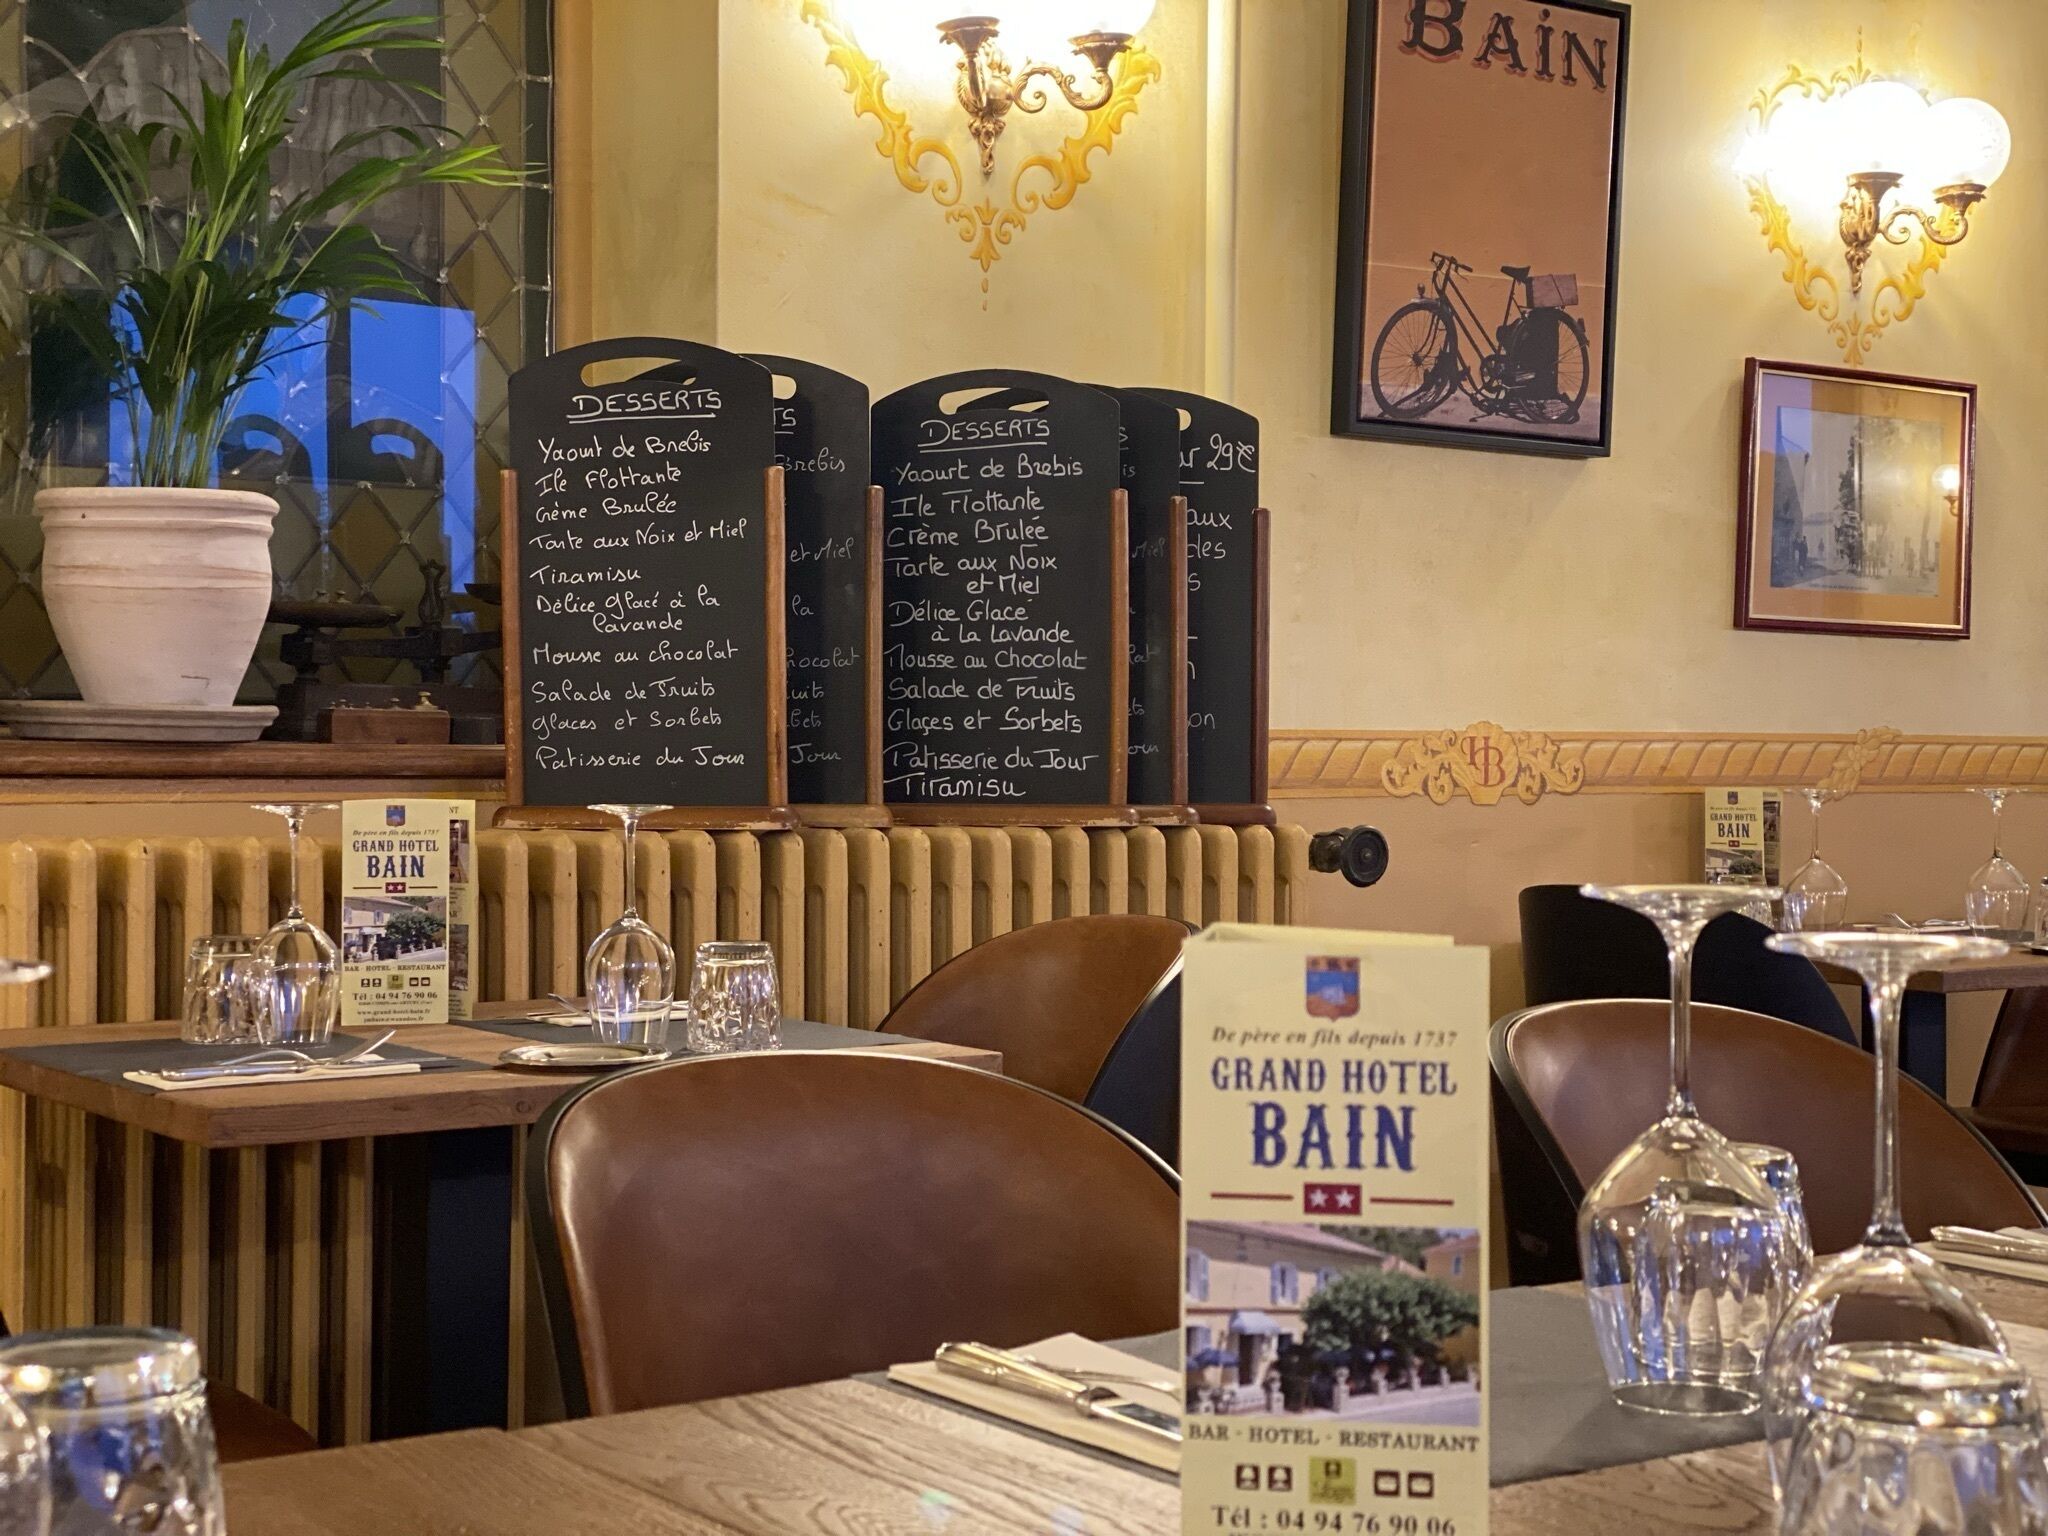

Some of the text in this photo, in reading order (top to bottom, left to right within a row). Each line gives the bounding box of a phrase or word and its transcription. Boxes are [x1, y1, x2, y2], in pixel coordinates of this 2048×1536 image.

[566, 388, 722, 418] DESSERTS
[918, 418, 1050, 448] DESSERTS
[612, 441, 635, 458] de
[585, 461, 682, 490] Flottante
[895, 453, 1083, 485] Yaourt de Brebis
[891, 486, 1045, 517] Ile Flottante
[593, 534, 629, 548] aux
[635, 522, 675, 545] Noix
[684, 520, 702, 542] et
[709, 518, 747, 540] Miel
[887, 516, 1049, 547] Crème Brulée
[884, 544, 1058, 577] Tarte aux Noix
[529, 565, 641, 585] Tiramisu
[967, 572, 1040, 595] et Miel
[670, 592, 686, 608] à
[697, 584, 720, 607] la
[889, 598, 960, 627] Délice
[931, 625, 949, 643] à
[532, 642, 601, 664] Mousse
[615, 652, 639, 663] au
[964, 655, 988, 668] au
[532, 679, 611, 703] Salade
[625, 682, 646, 700] de
[887, 676, 1076, 701] Salade de Fruits
[615, 709, 638, 730] et
[650, 707, 722, 727] Sorbets
[963, 709, 992, 730] et
[999, 706, 1083, 734] Sorbets
[535, 745, 745, 770] Patisserie du Jour
[883, 741, 1099, 771] Patisserie du Jour
[883, 772, 1026, 797] Tiramisu
[1710, 812, 1757, 821] GRAND HOTEL
[1718, 823, 1750, 838] BAIN
[353, 840, 439, 852] GRAND HOTEL
[366, 855, 425, 878] BAIN
[1211, 1026, 1457, 1049] De père en fils depuis 1737
[1211, 1056, 1458, 1095] GRAND HOTEL
[1250, 1100, 1417, 1172] BAIN
[1188, 1424, 1480, 1452] BAR HOTEL RESTAURANT
[1211, 1504, 1456, 1536] Tél 04 94 76 90 06
